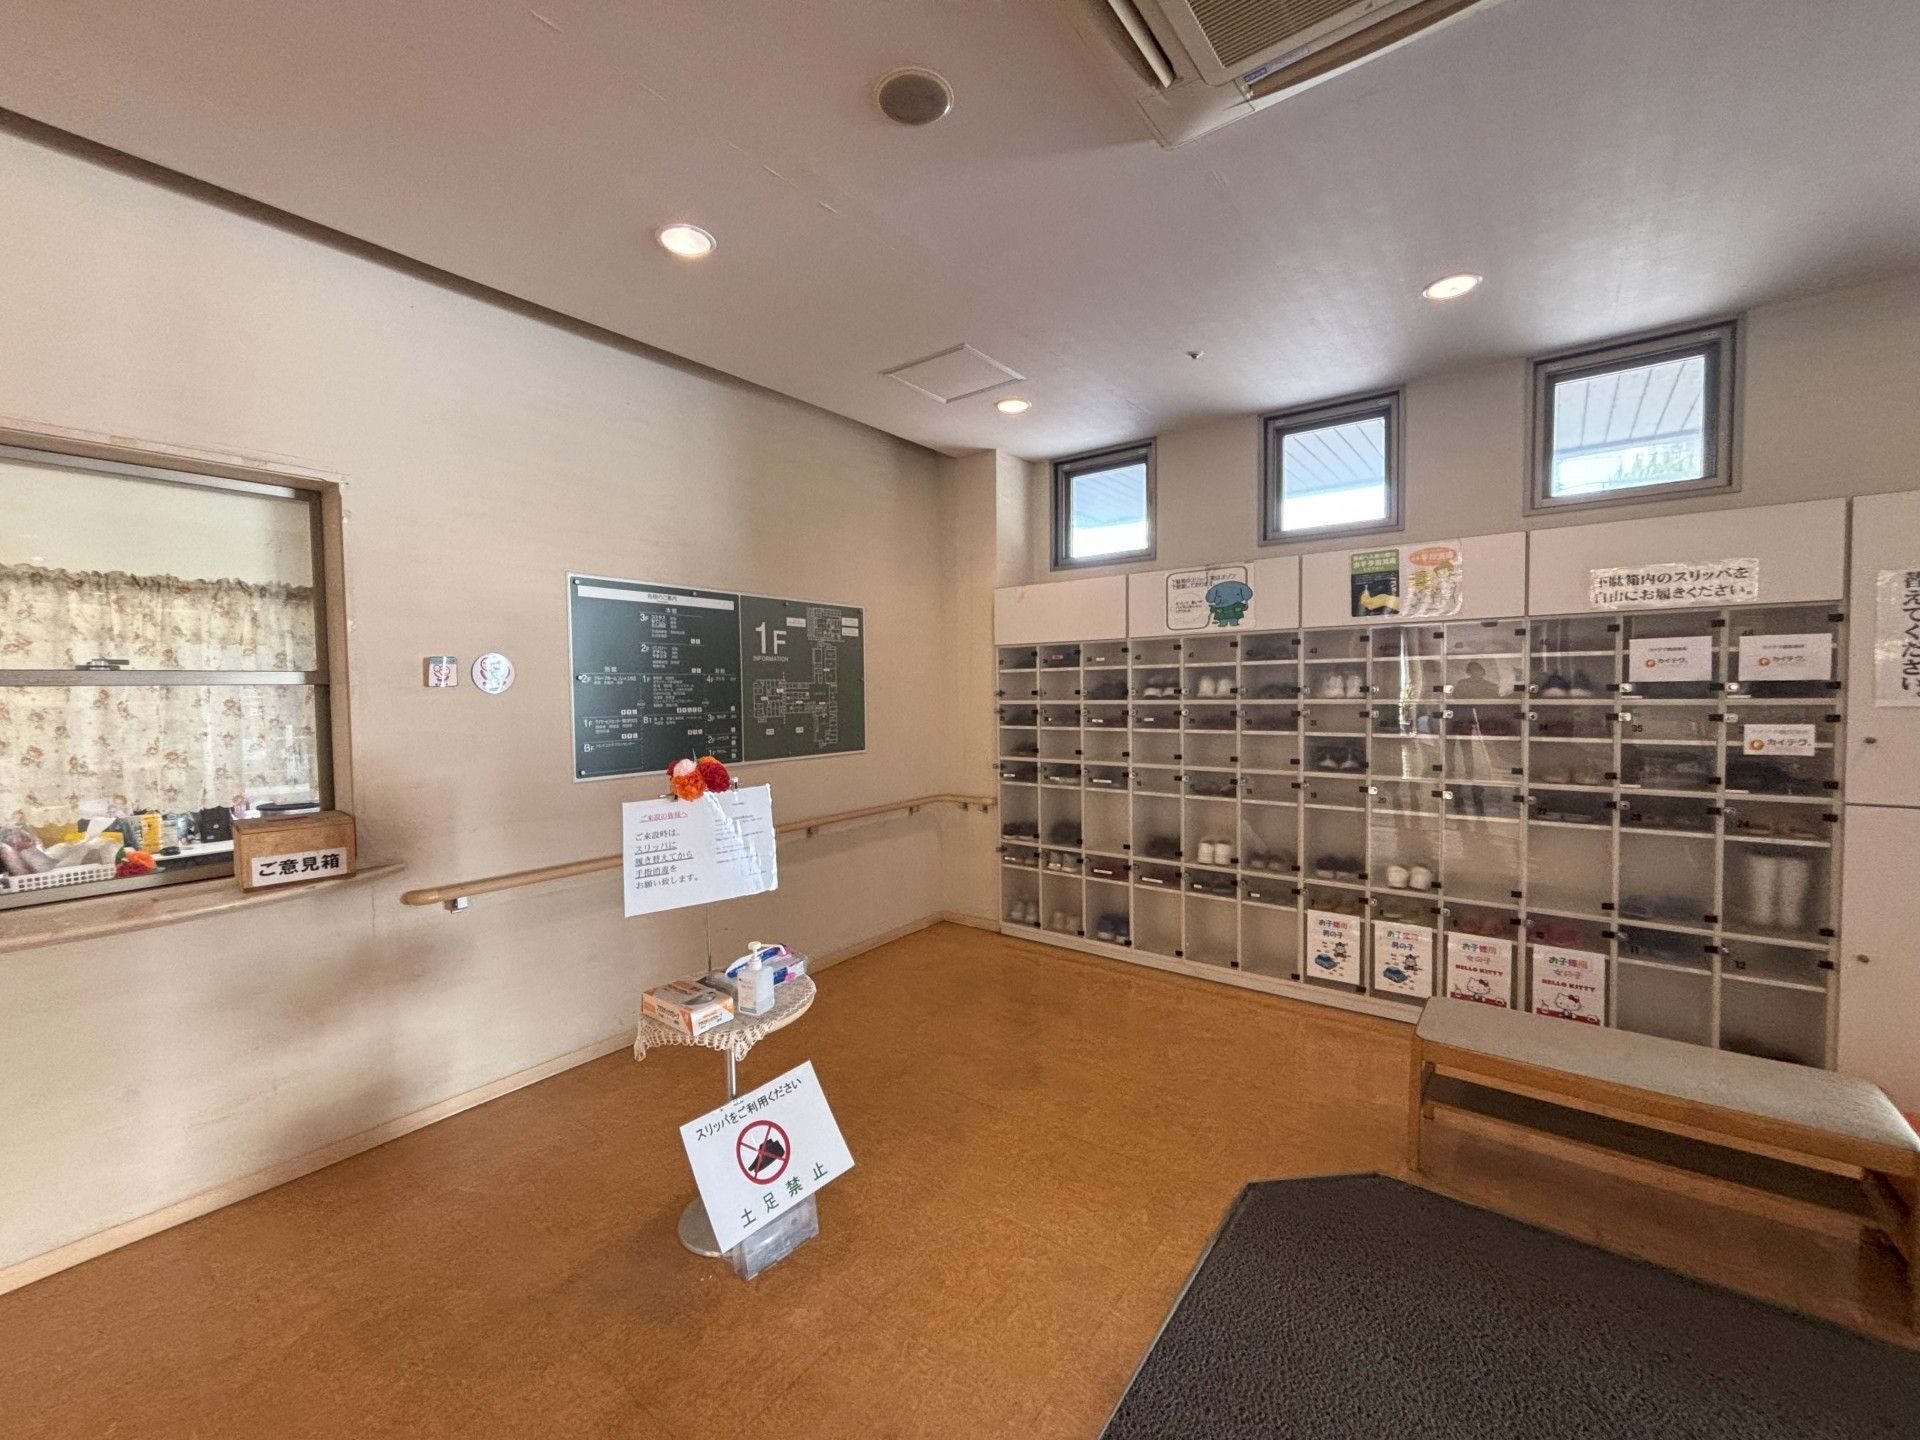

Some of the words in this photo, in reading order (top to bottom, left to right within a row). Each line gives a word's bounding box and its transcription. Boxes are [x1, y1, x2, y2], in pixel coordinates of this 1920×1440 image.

[1598, 567, 1749, 588] 下駄箱内のスリッパを
[755, 621, 787, 655] 1F
[636, 841, 677, 854] スリッパに
[259, 853, 340, 877] ご意見箱
[635, 851, 693, 866] 履き替えてから
[636, 874, 699, 889] お願い致します。
[1455, 964, 1478, 972] HELLO
[1479, 968, 1504, 977] KITTY
[1541, 978, 1568, 988] HELLO
[1569, 983, 1596, 993] KITTY
[696, 1078, 802, 1141] スリッパをご利用ください
[741, 1162, 828, 1228] 土足禁止
